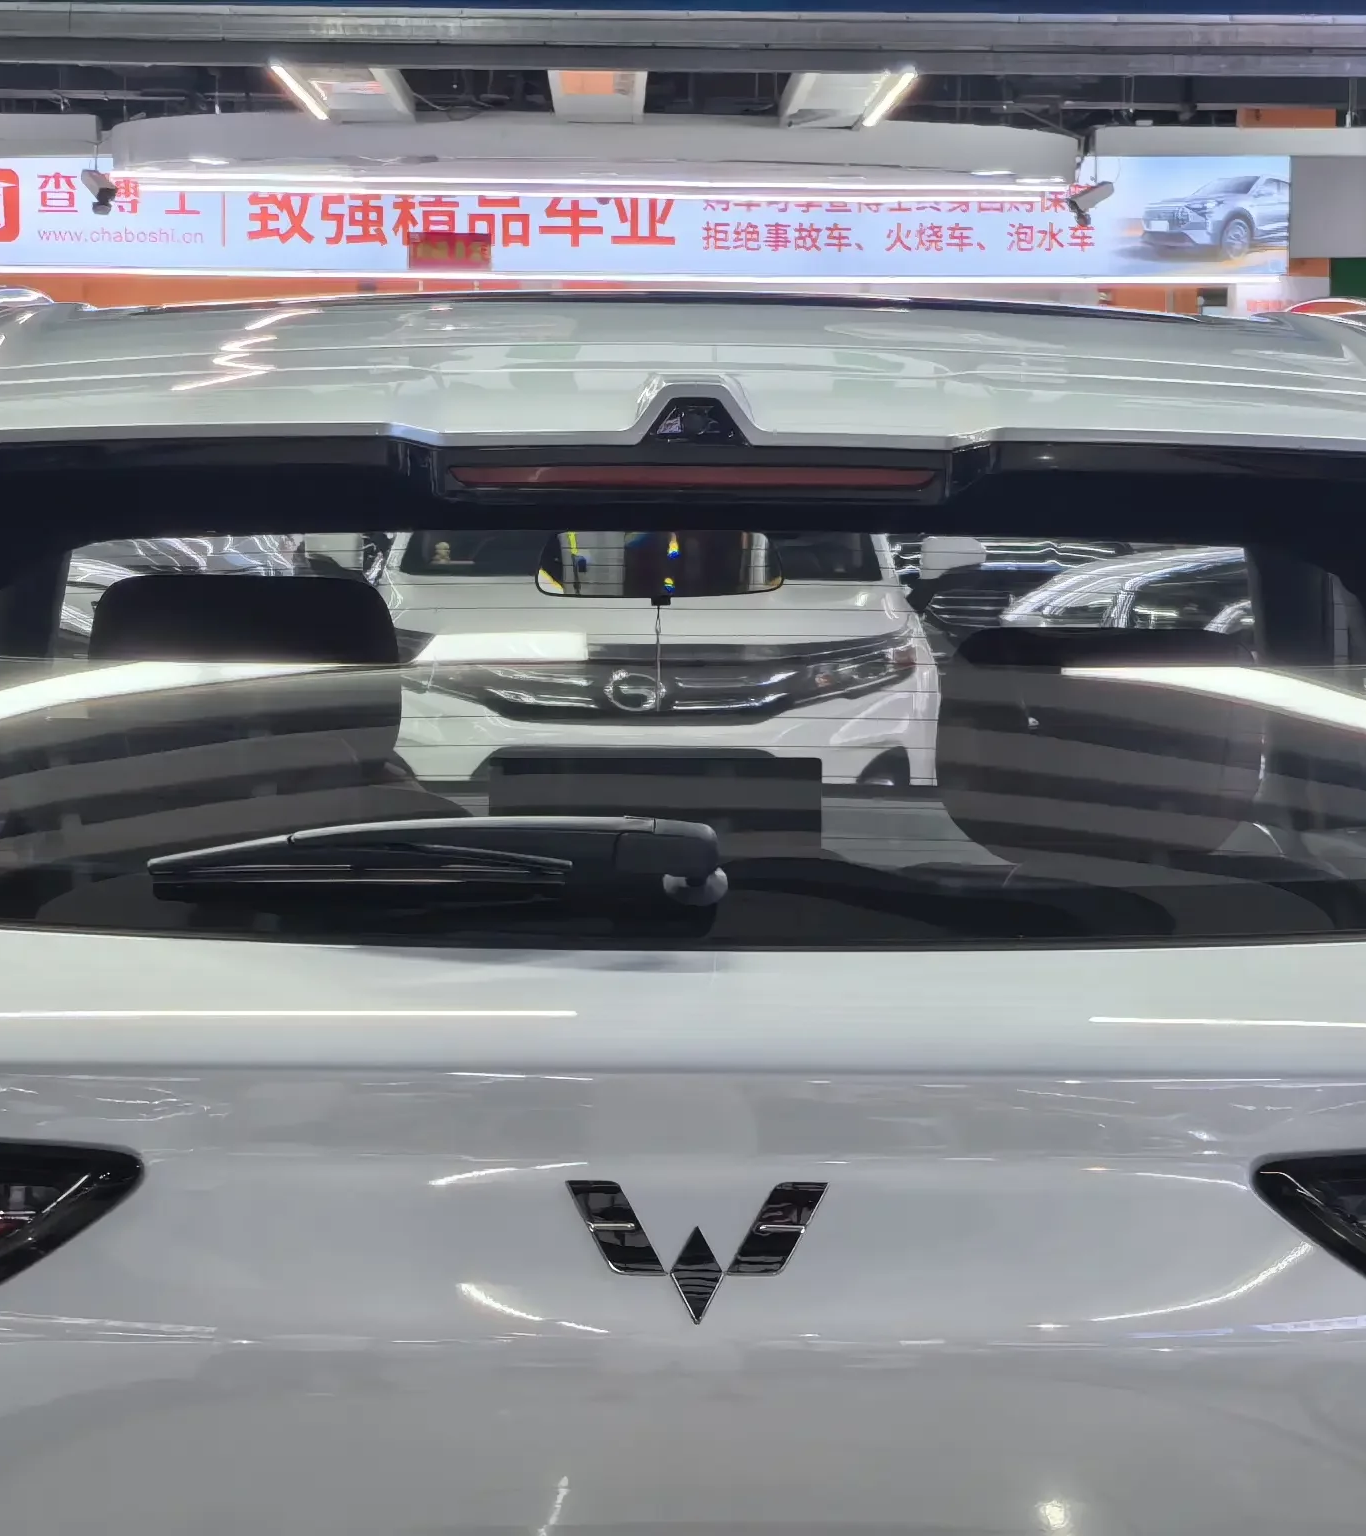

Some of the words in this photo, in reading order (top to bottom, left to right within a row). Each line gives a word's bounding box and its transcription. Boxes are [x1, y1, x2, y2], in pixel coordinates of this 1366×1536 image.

[37, 226, 204, 245] www.chaboshi.cn
[701, 221, 1096, 253] 拒绝事故车、火烧车、泡水车
